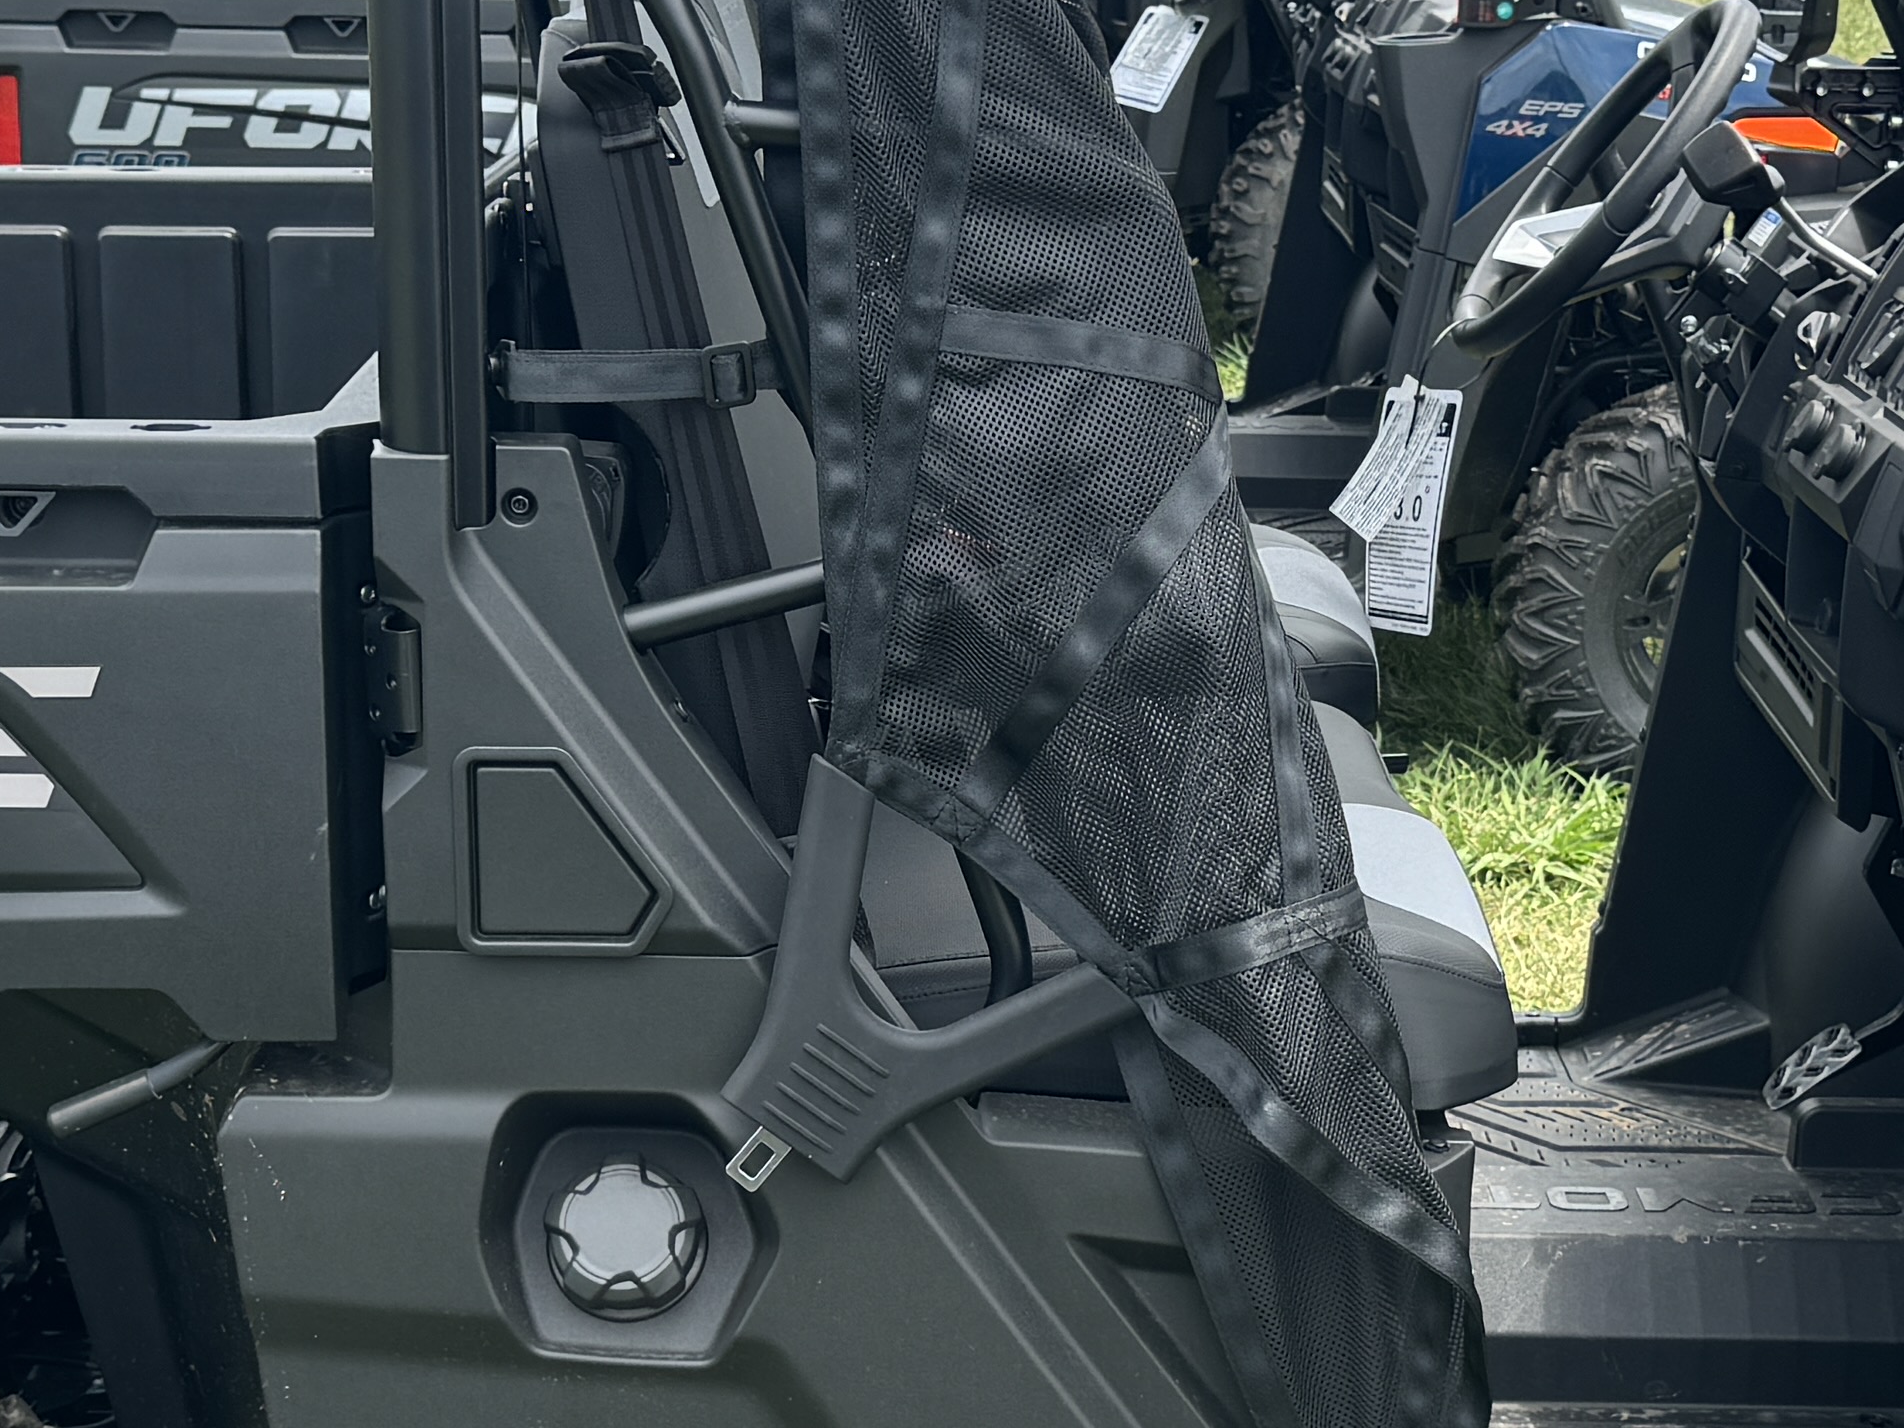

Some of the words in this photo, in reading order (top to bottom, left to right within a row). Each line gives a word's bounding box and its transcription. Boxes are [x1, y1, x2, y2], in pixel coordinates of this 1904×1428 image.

[1519, 99, 1585, 118] EPS
[1485, 119, 1549, 138] 4X4
[1470, 1184, 1903, 1217] CFMOT
